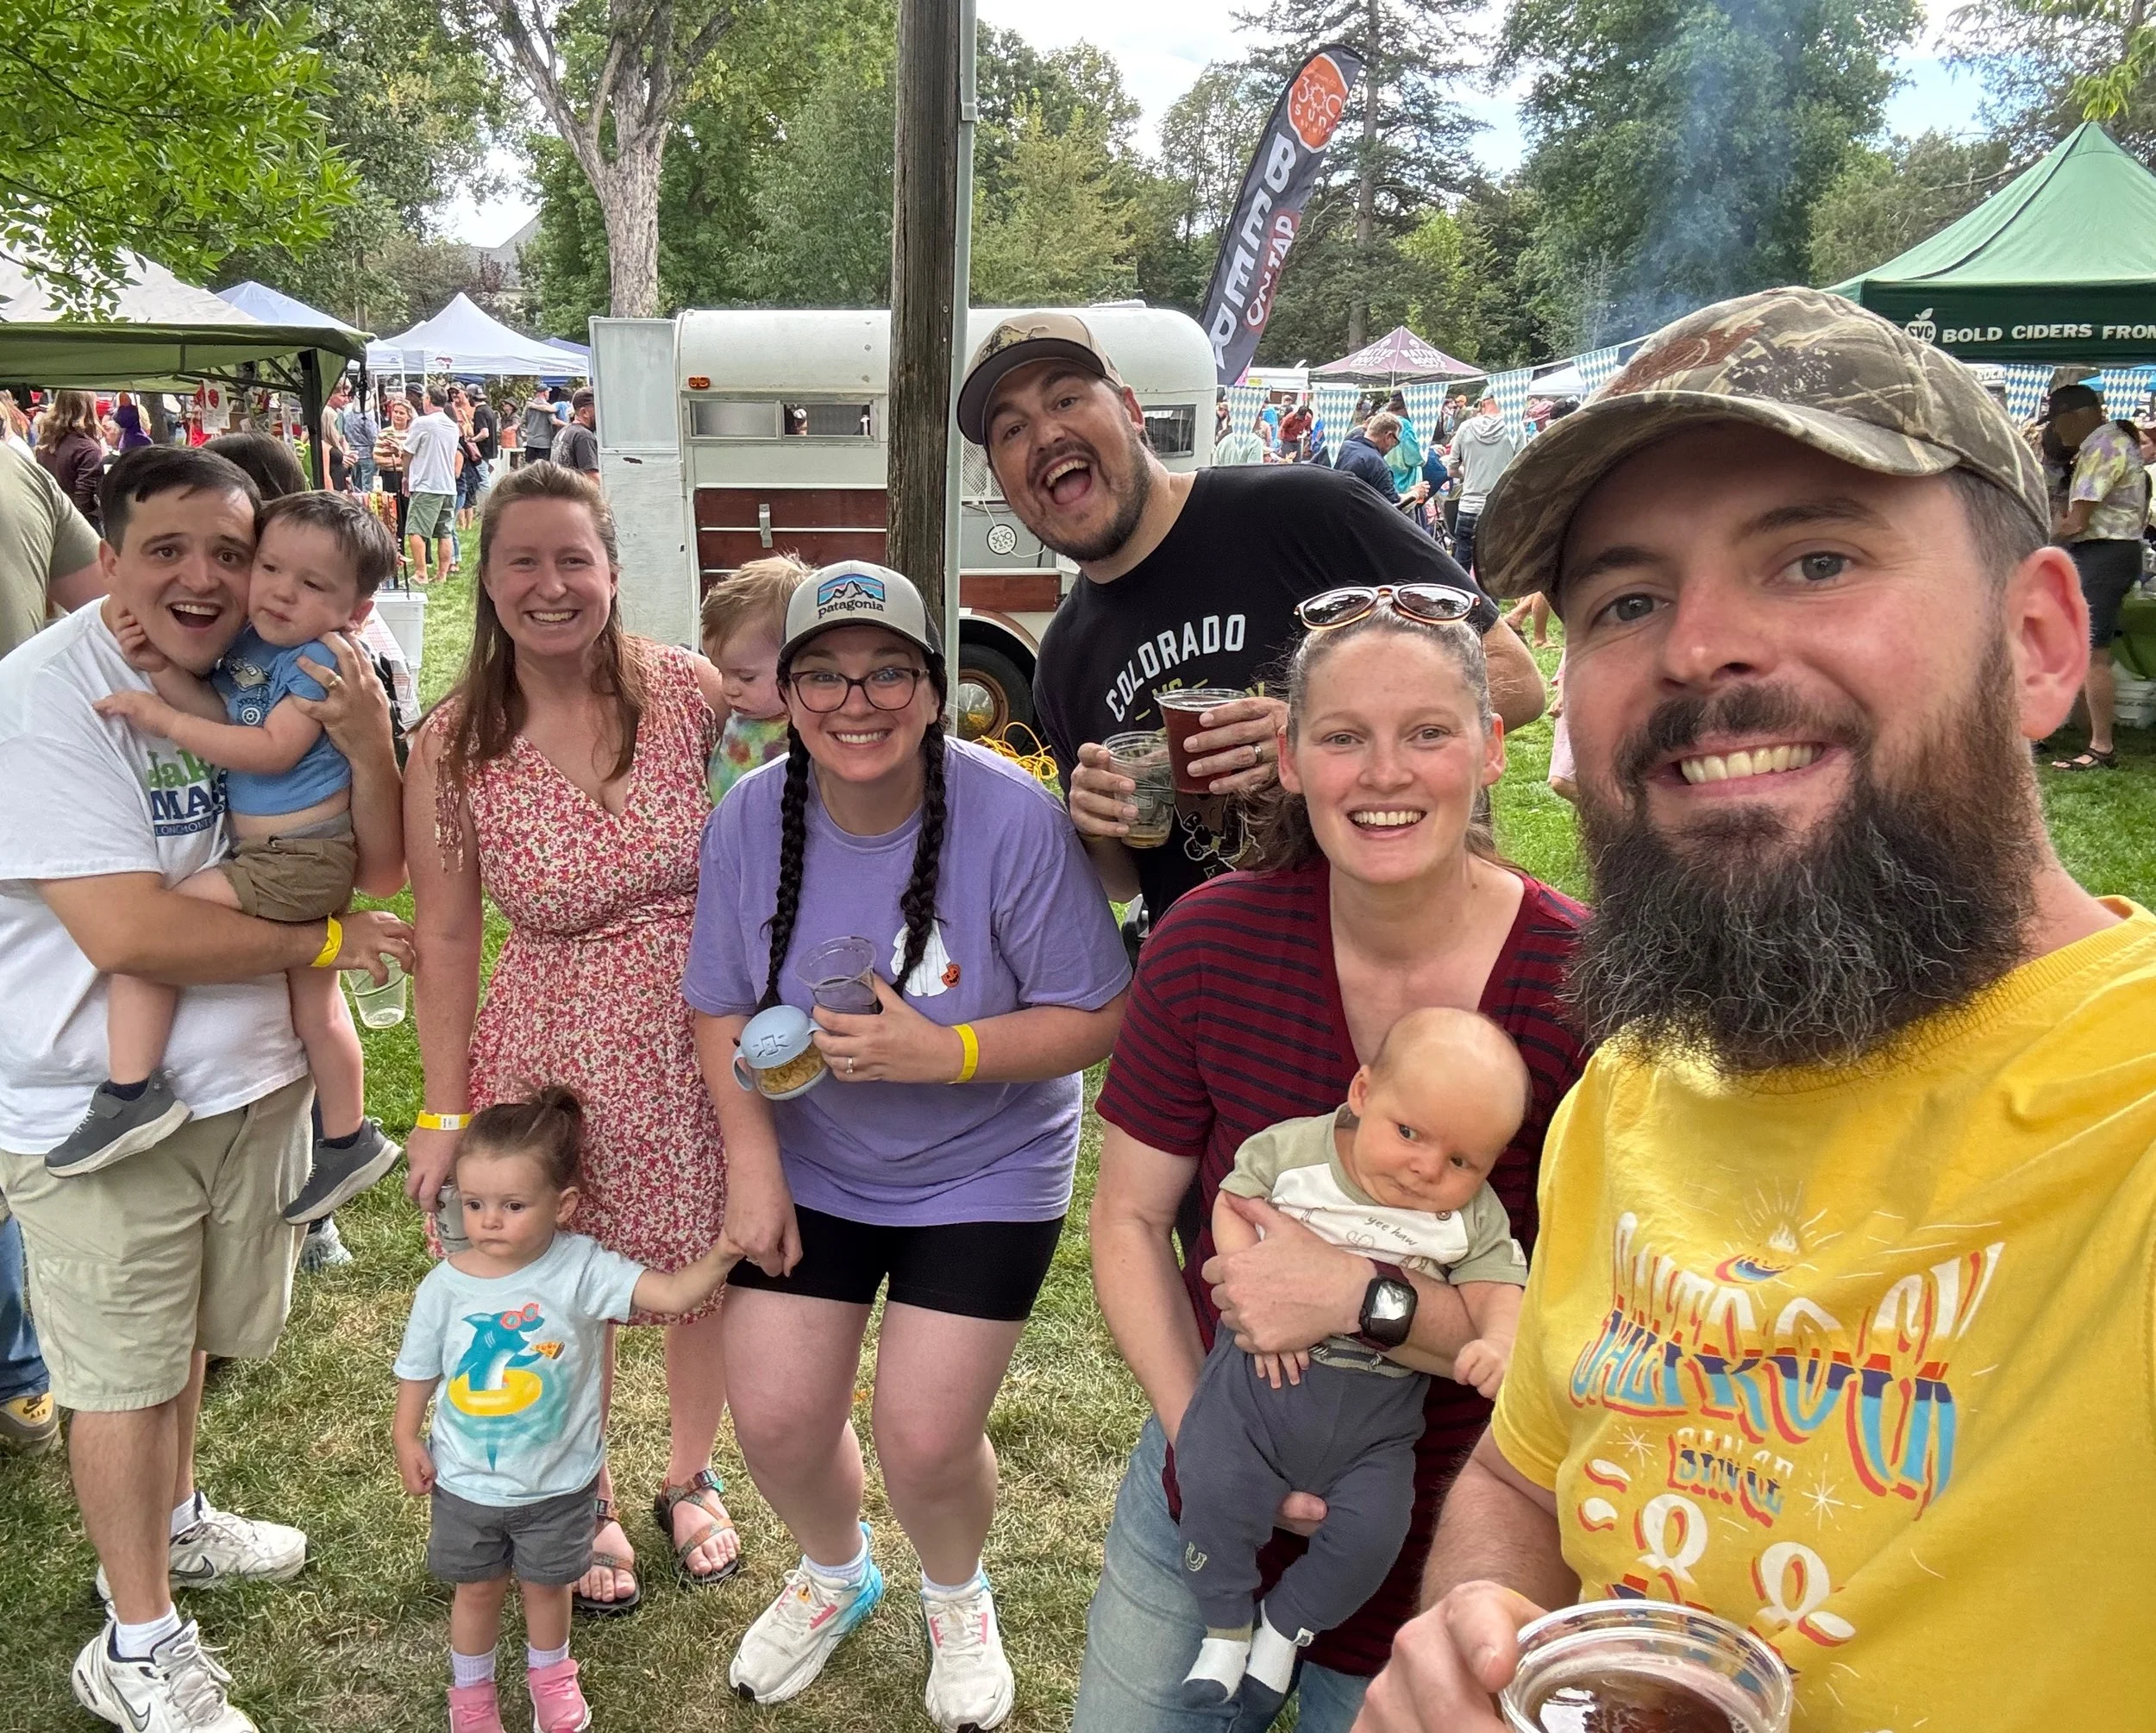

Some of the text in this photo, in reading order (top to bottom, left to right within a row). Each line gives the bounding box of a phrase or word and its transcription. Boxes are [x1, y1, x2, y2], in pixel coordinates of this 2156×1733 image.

[1208, 131, 1296, 370] BEER
[1942, 327, 2002, 343] BOLD
[2011, 324, 2092, 340] CIDERS
[818, 600, 884, 619] patagonia
[1106, 613, 1246, 722] COLORADO
[1364, 1216, 1418, 1246] yee haw
